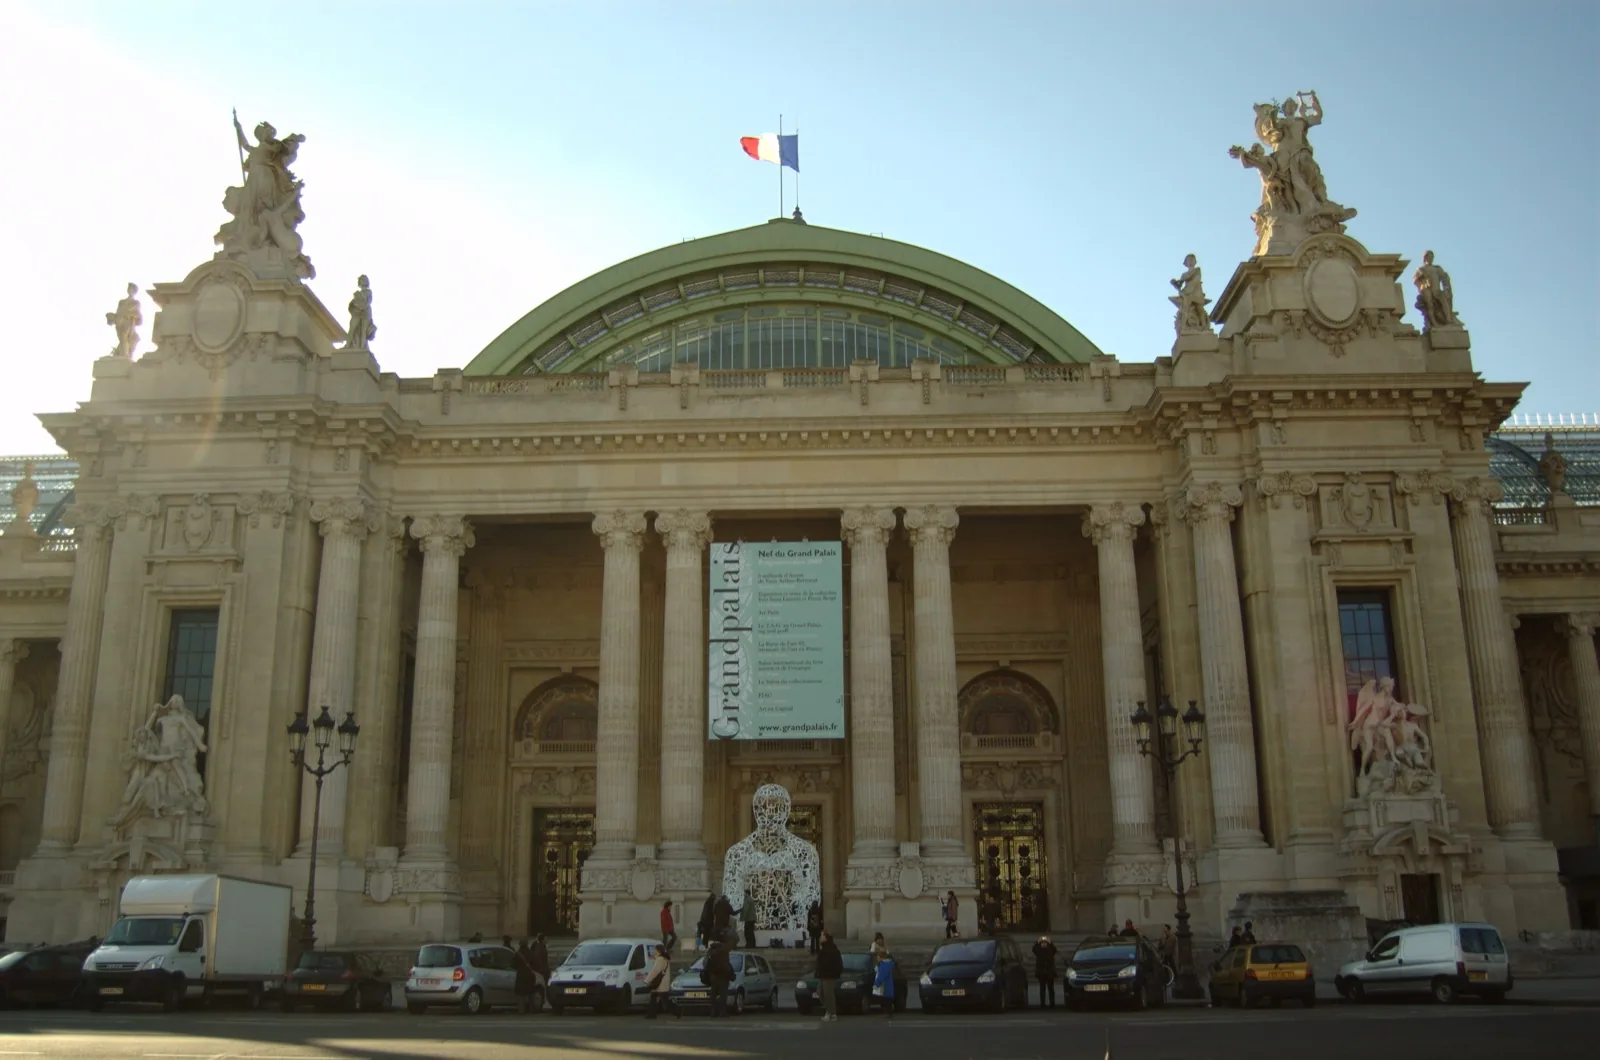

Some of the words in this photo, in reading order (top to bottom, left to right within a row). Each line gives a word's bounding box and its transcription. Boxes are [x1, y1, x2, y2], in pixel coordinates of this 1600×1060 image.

[758, 550, 773, 558] Nef
[775, 550, 787, 558] du
[787, 549, 812, 557] Grand
[814, 549, 837, 557] Palais
[758, 723, 838, 733] www.grandpalais.fr
